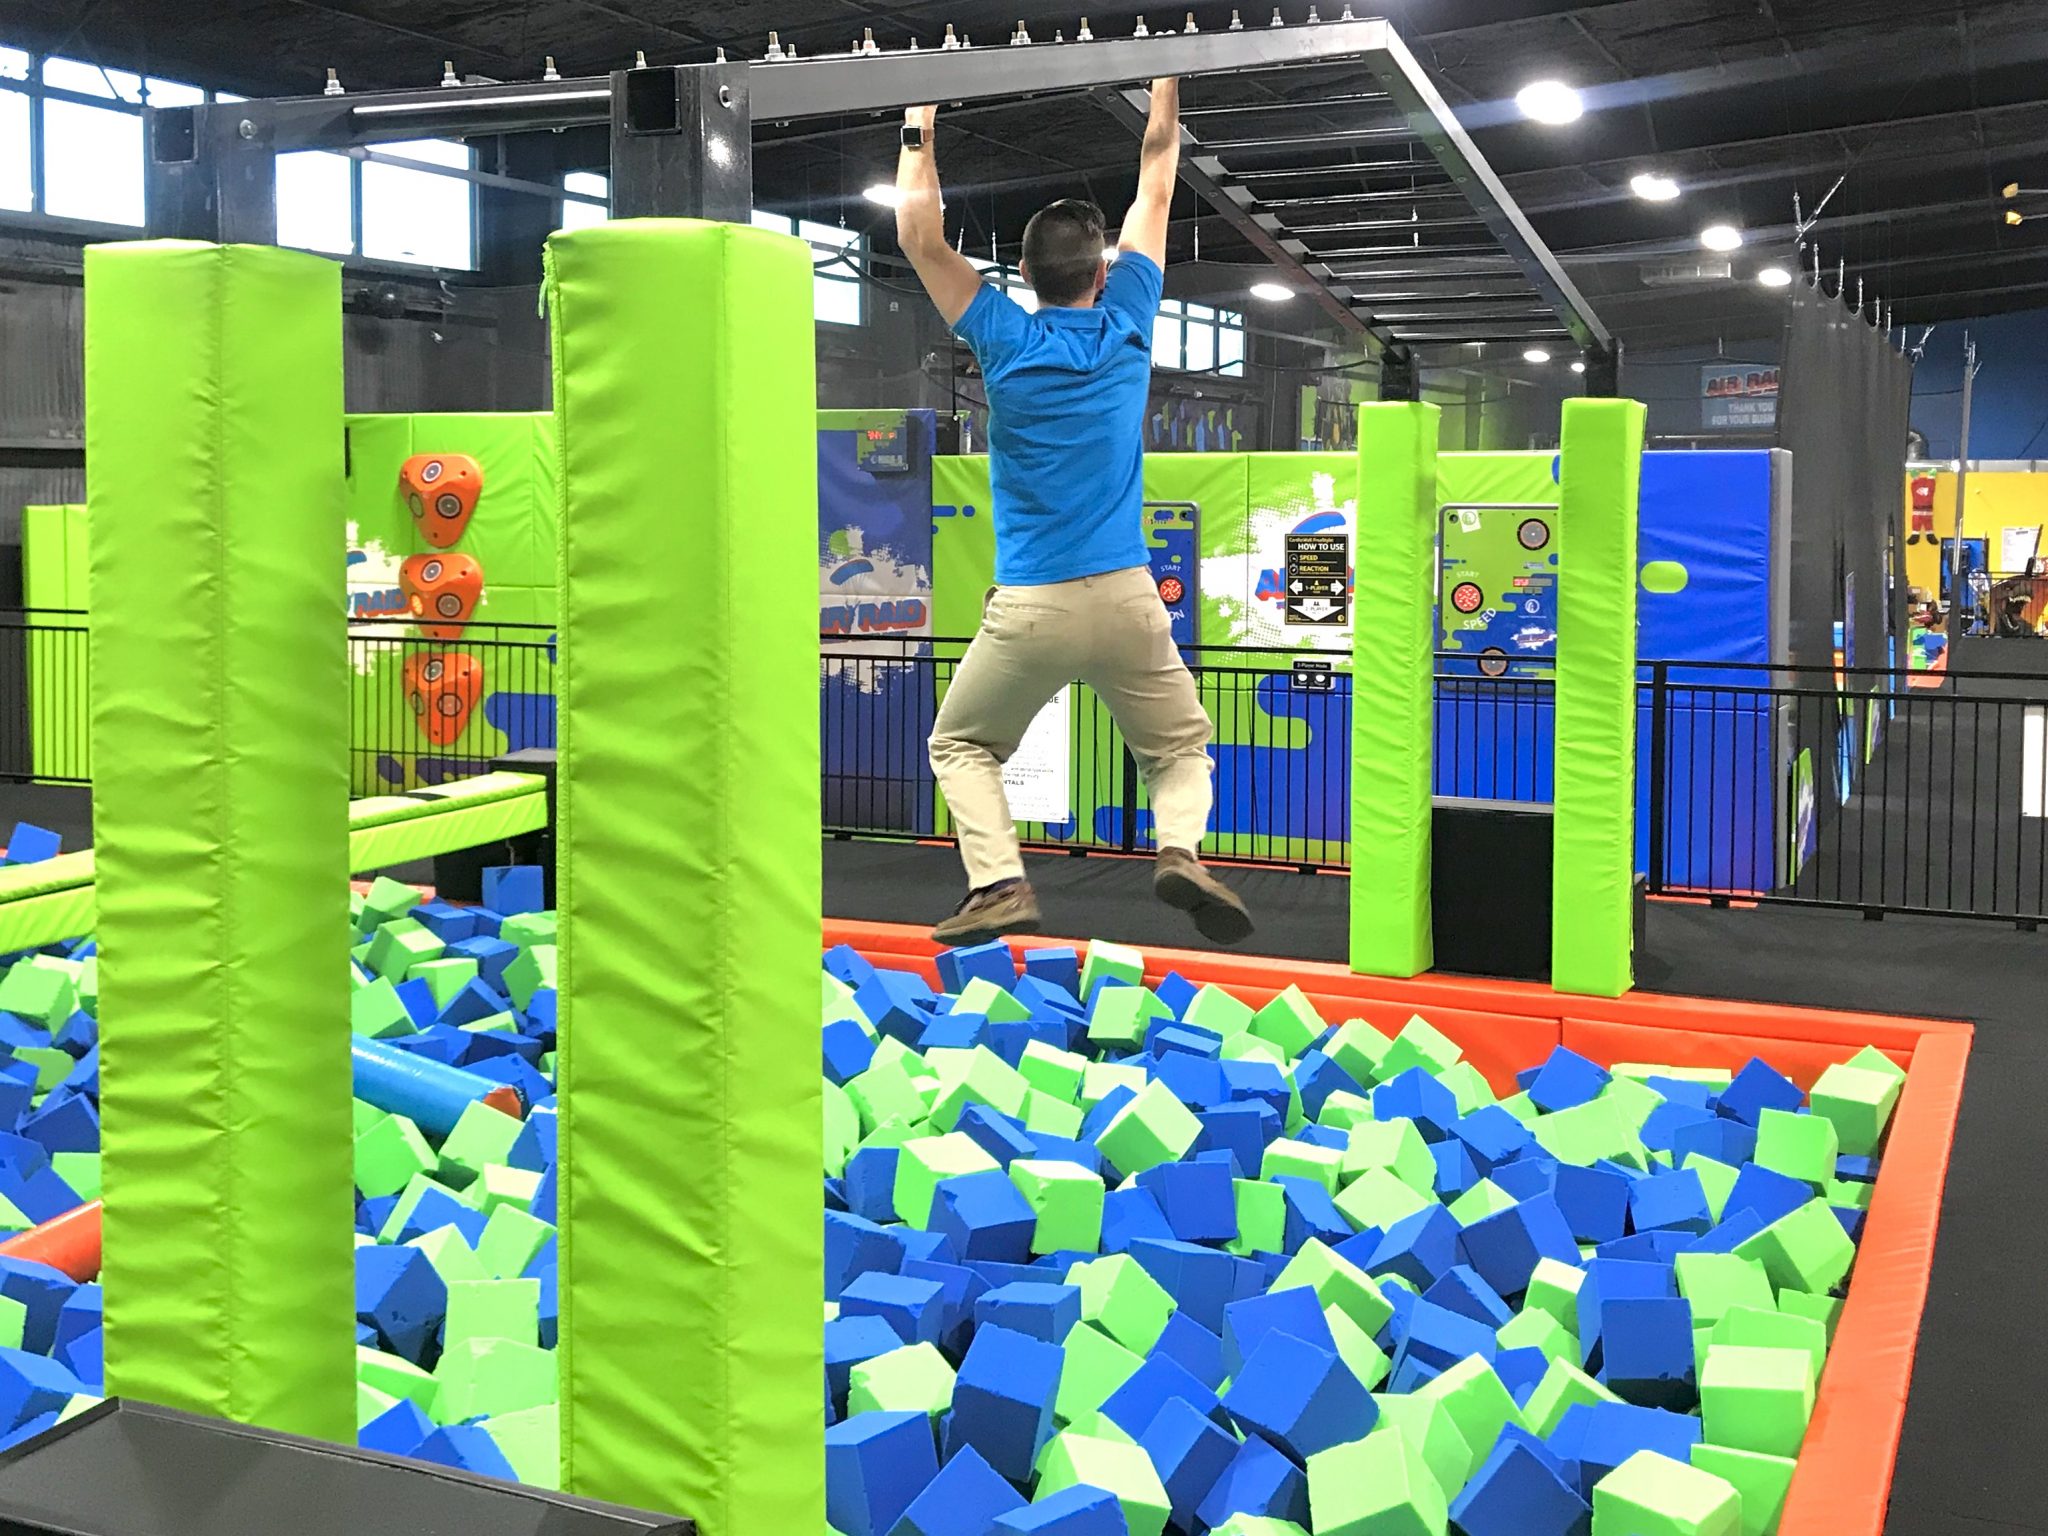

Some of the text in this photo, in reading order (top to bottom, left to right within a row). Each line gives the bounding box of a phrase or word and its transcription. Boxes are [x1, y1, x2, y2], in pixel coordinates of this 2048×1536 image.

[1728, 401, 1774, 413] THANK YOU
[1711, 415, 1728, 425] FOR
[1728, 414, 1750, 424] YOUR
[1330, 543, 1345, 551] USE
[1160, 564, 1182, 572] START
[1456, 570, 1480, 578] START
[354, 588, 407, 617] RAID
[858, 599, 926, 632] RAID
[1463, 607, 1497, 630] SPEED
